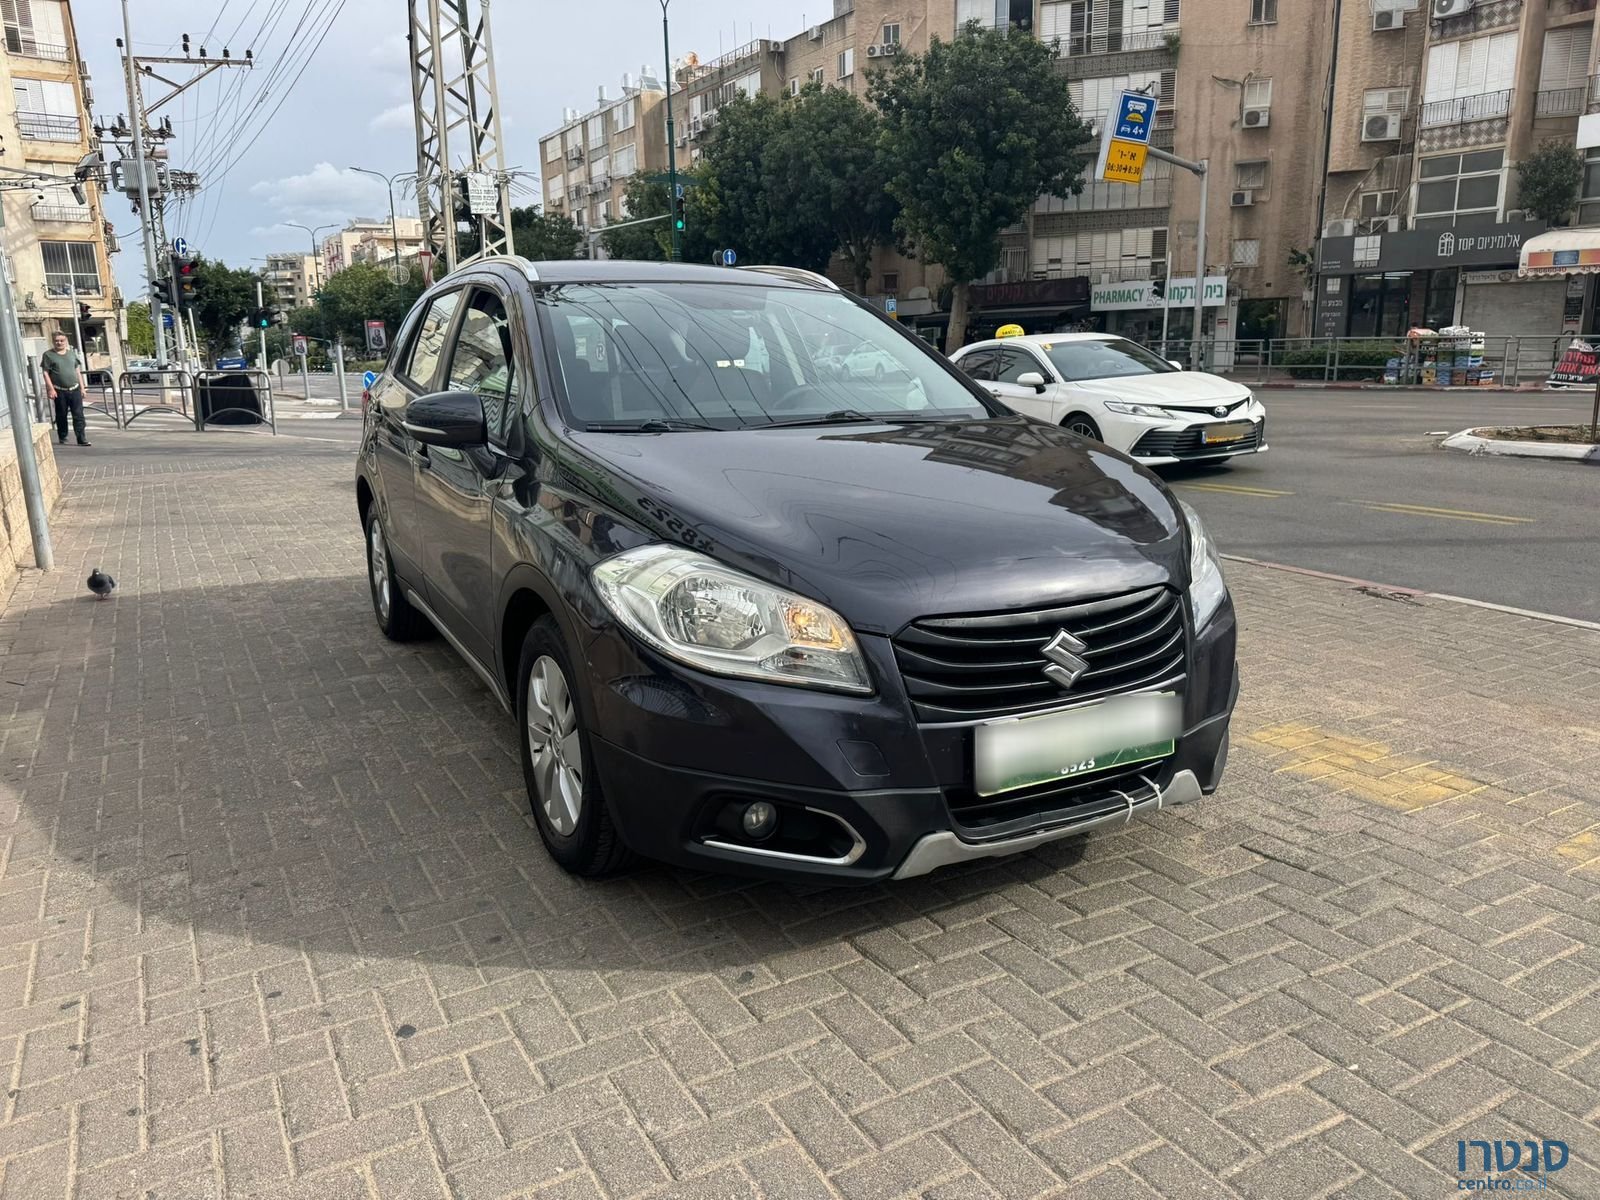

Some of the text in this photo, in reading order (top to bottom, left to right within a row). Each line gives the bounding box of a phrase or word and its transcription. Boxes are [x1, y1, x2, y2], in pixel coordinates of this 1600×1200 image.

[1132, 125, 1144, 135] 4+
[1458, 237, 1475, 251] TOP
[1477, 232, 1520, 250] אלומיניום
[1093, 288, 1145, 304] PHARMACY
[1204, 284, 1223, 299] בית
